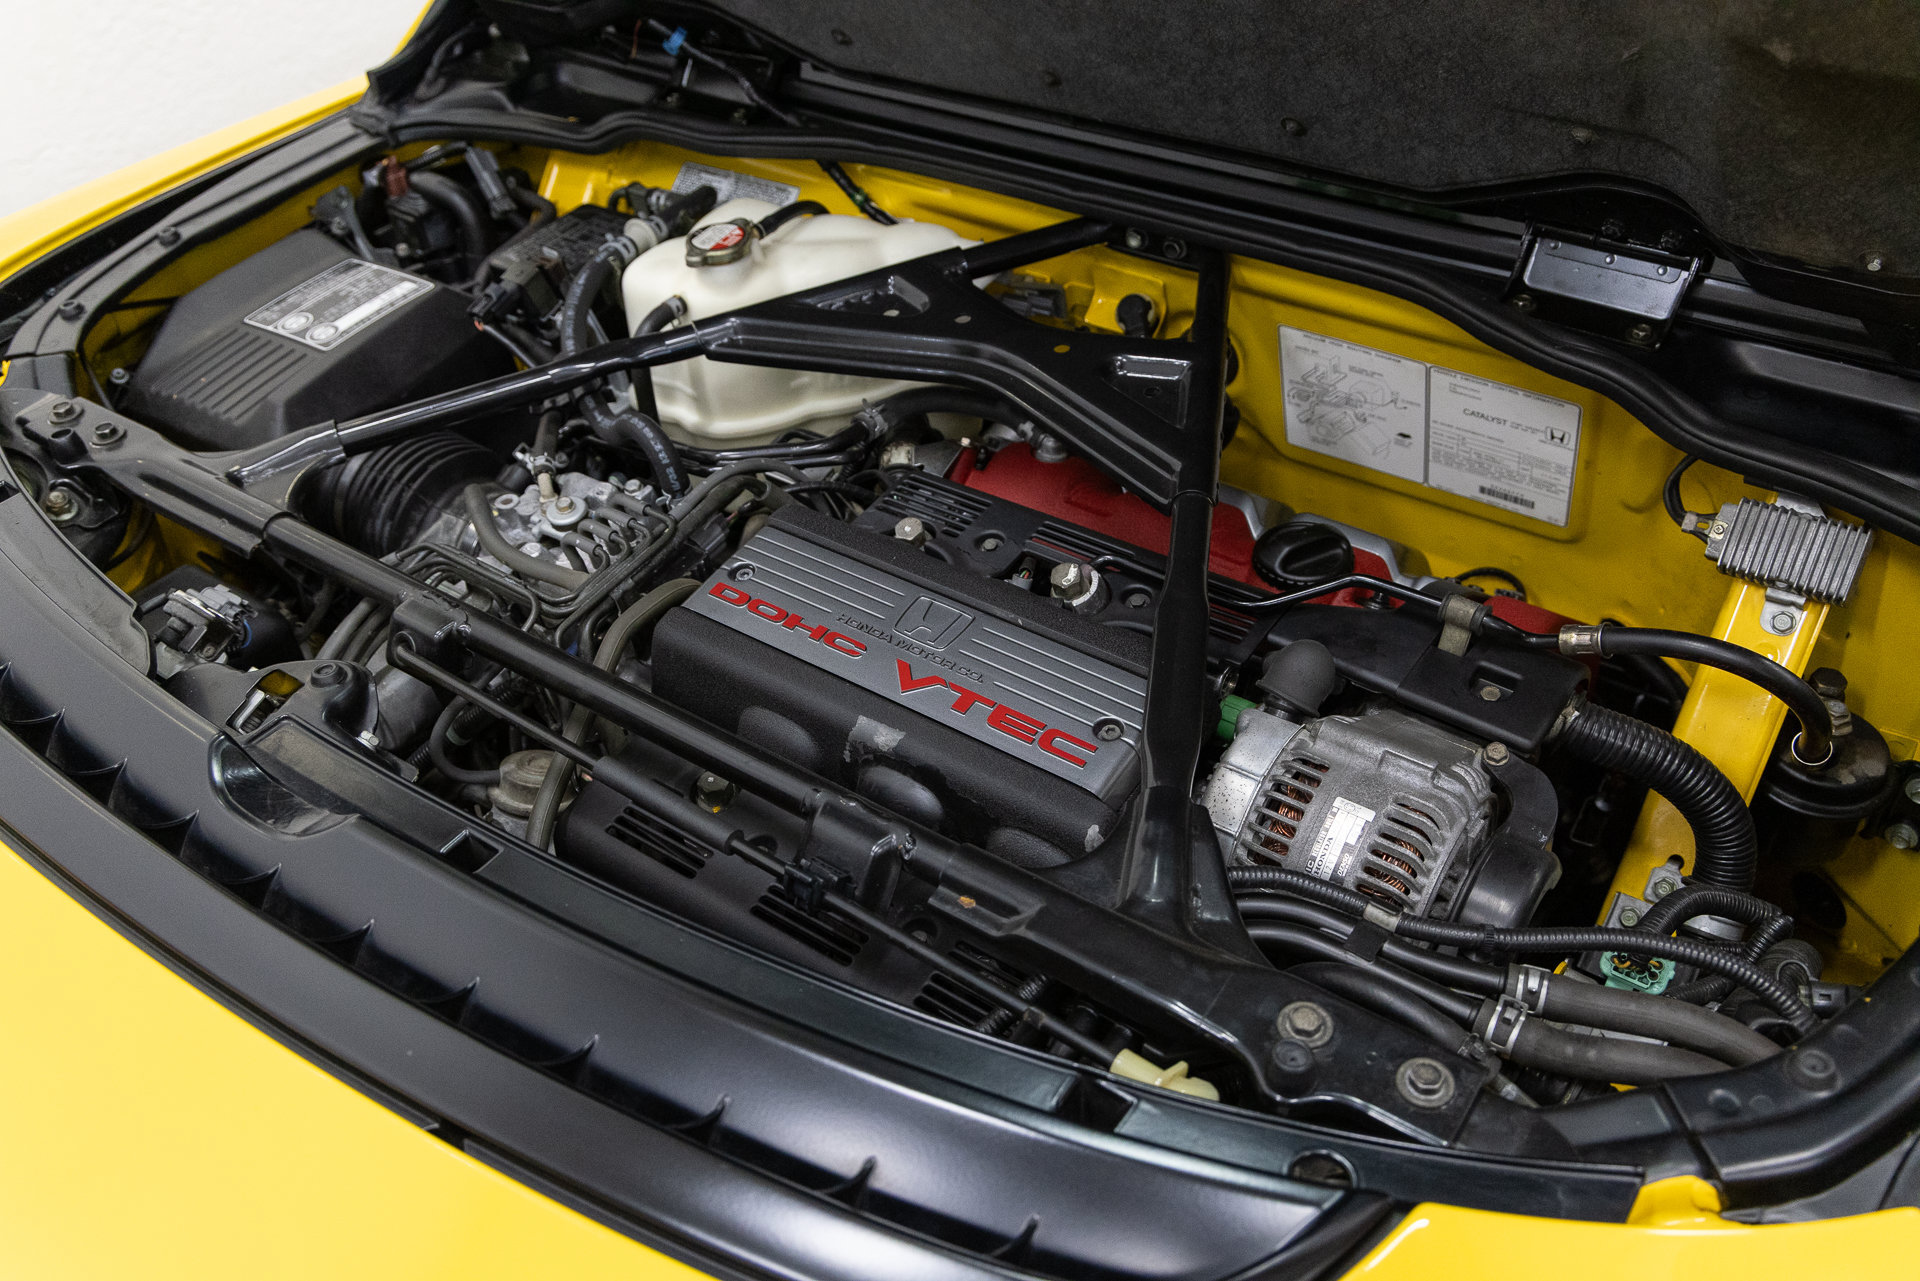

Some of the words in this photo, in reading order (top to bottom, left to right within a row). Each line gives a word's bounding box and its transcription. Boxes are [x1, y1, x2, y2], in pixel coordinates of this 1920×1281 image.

[1463, 408, 1508, 426] CATALYST
[836, 612, 894, 644] HONDA
[899, 638, 957, 671] MOTOR
[956, 663, 985, 685] CO.
[708, 582, 868, 660] DOHC
[896, 658, 1099, 770] VTEC
[1313, 837, 1334, 875] HONDA
[1337, 853, 1350, 876] DENSO
